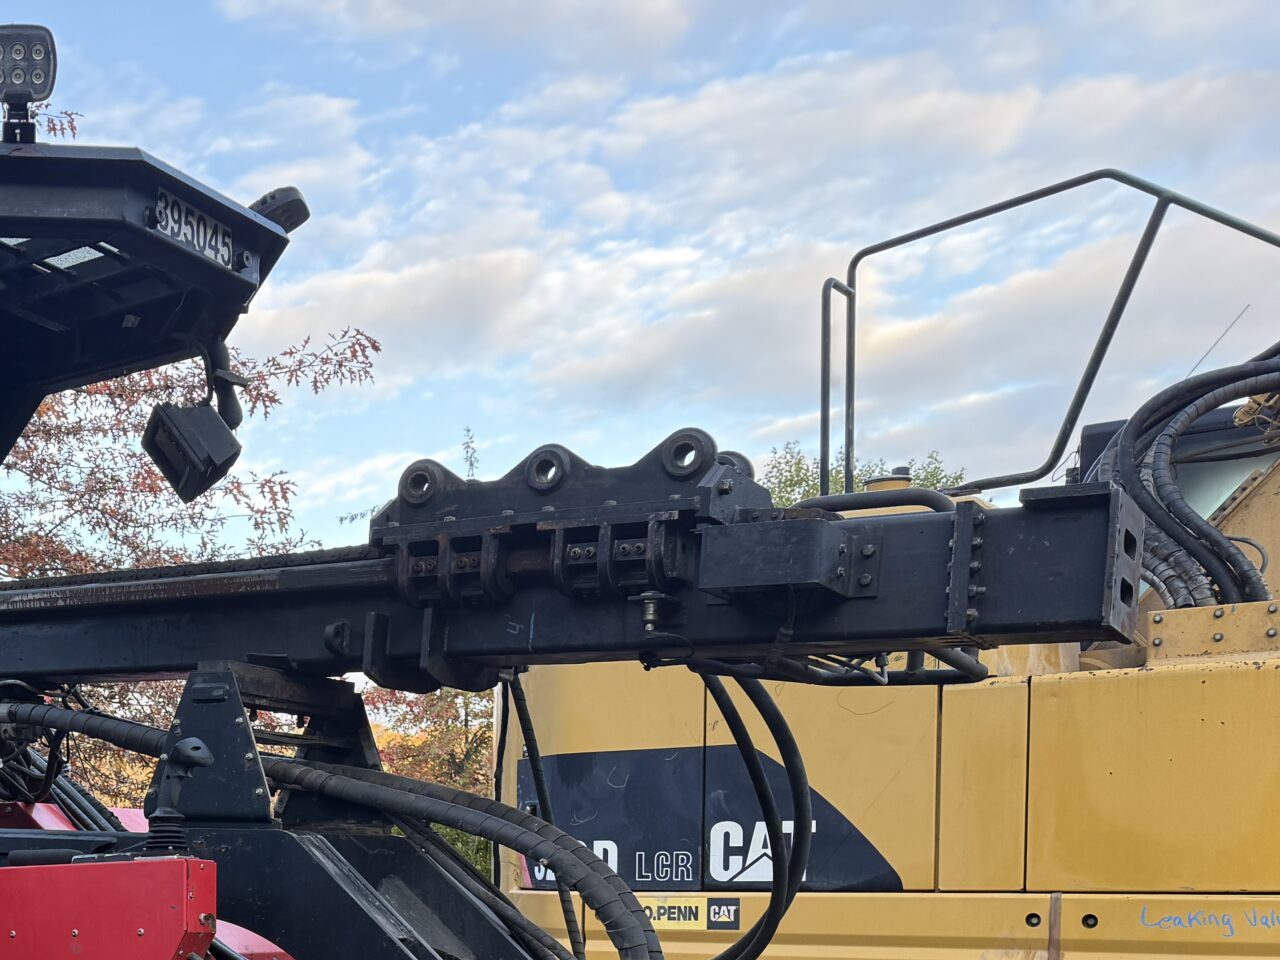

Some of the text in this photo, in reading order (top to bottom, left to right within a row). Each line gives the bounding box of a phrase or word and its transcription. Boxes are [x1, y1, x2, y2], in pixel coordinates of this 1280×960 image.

[158, 191, 232, 267] 395045
[635, 851, 693, 881] LCR
[709, 820, 817, 882] CA
[710, 905, 737, 922] CAT
